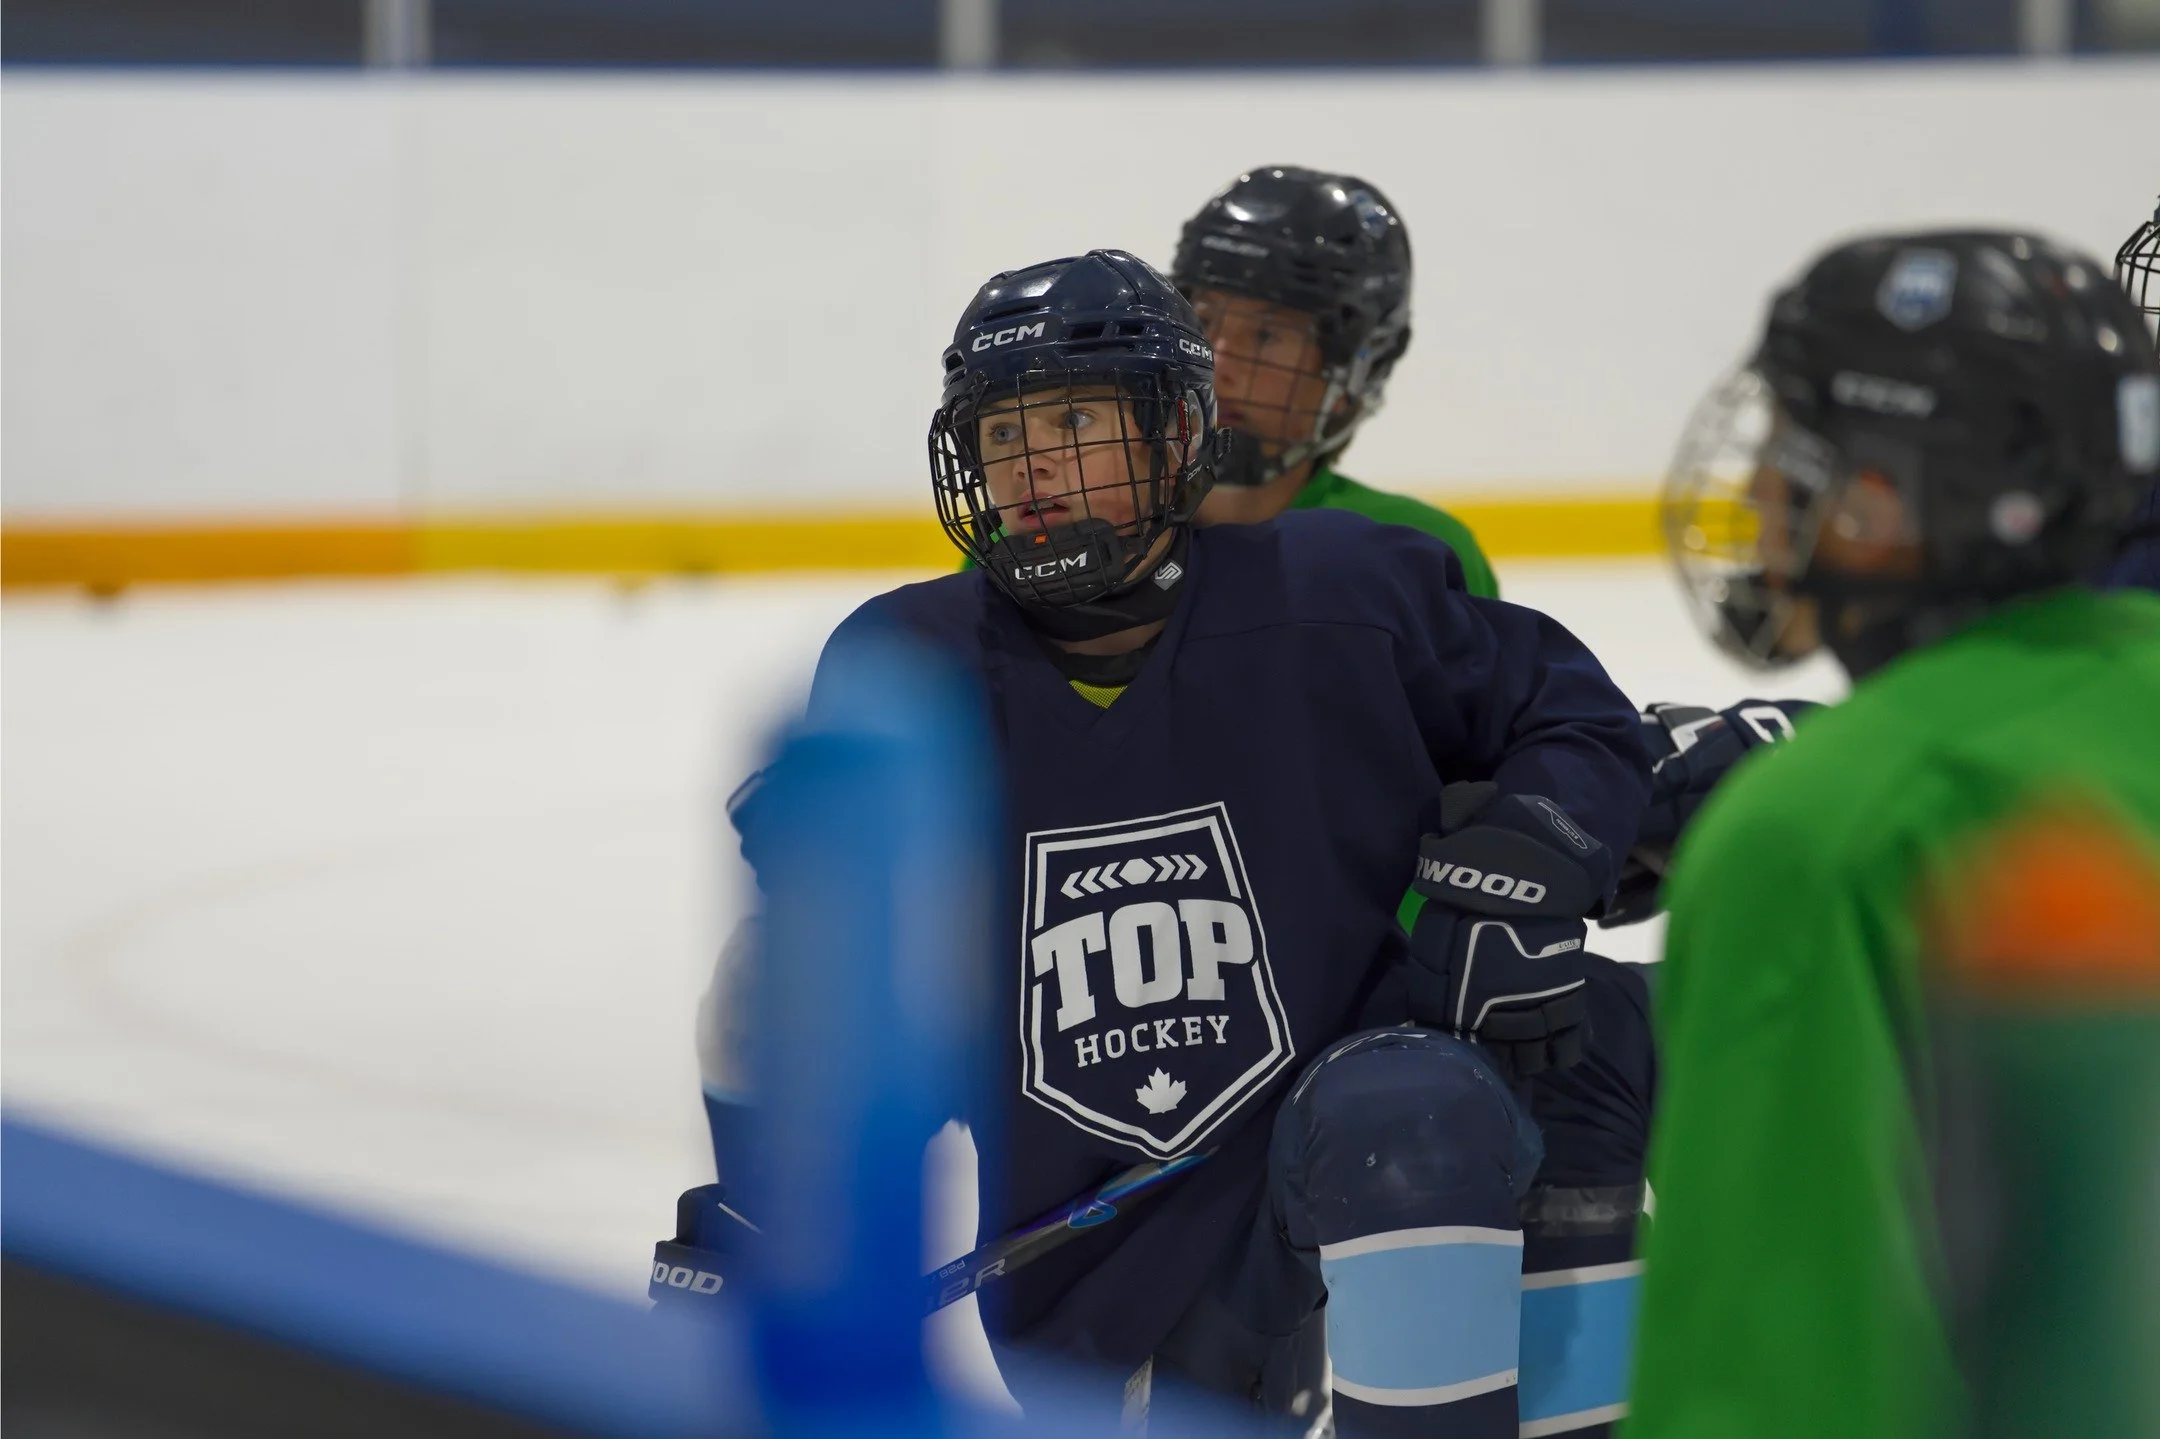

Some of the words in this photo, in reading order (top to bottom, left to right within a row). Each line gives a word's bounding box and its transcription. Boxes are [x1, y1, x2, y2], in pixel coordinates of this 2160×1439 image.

[971, 322, 1046, 353] CCM
[1179, 338, 1213, 362] CCM
[1014, 552, 1087, 580] CCM
[1031, 899, 1254, 1032] TOP
[1075, 1015, 1230, 1068] HOCKEY
[652, 1262, 724, 1295] OOD
